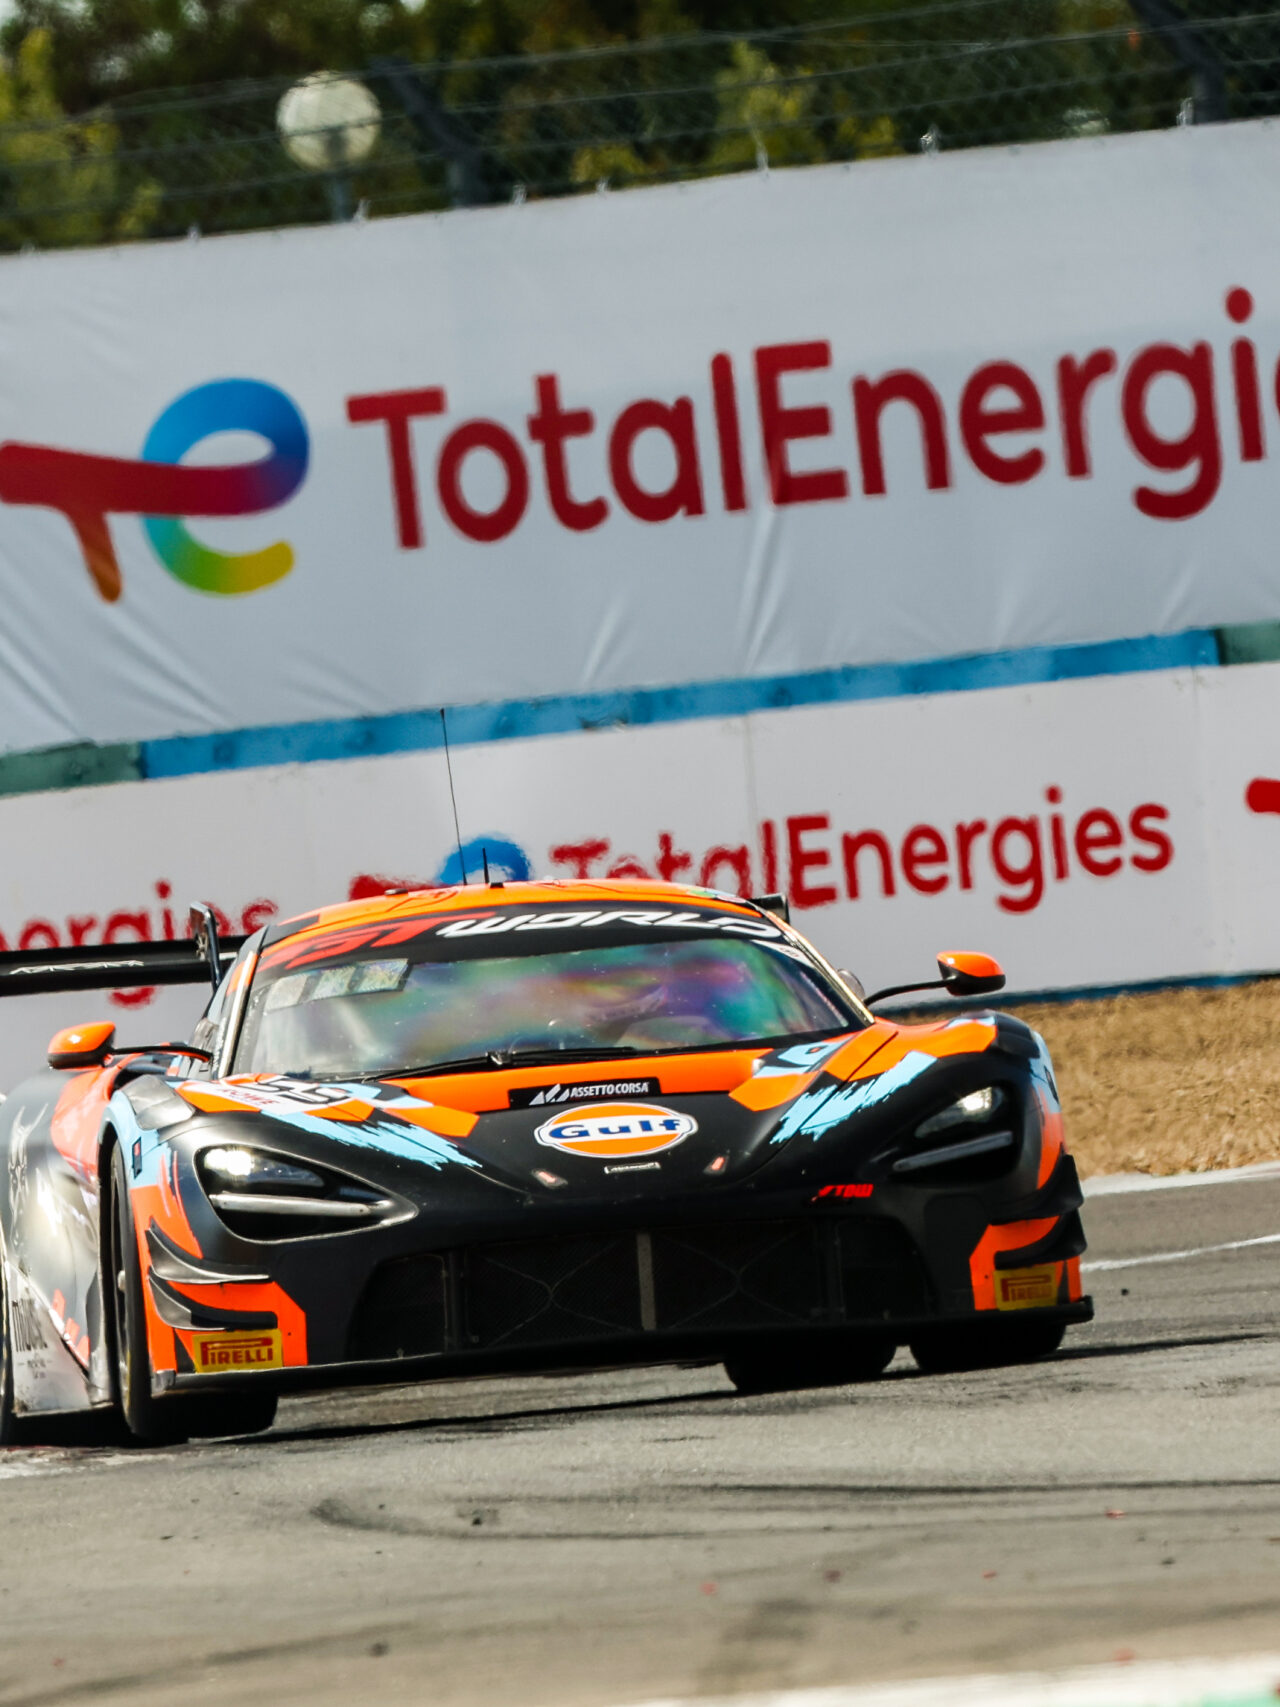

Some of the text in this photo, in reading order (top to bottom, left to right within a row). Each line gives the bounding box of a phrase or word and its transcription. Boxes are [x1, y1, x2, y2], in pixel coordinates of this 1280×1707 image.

[346, 288, 1280, 548] TotalEnergi
[549, 1119, 680, 1140] Gulf
[200, 1336, 274, 1366] PIRELLI
